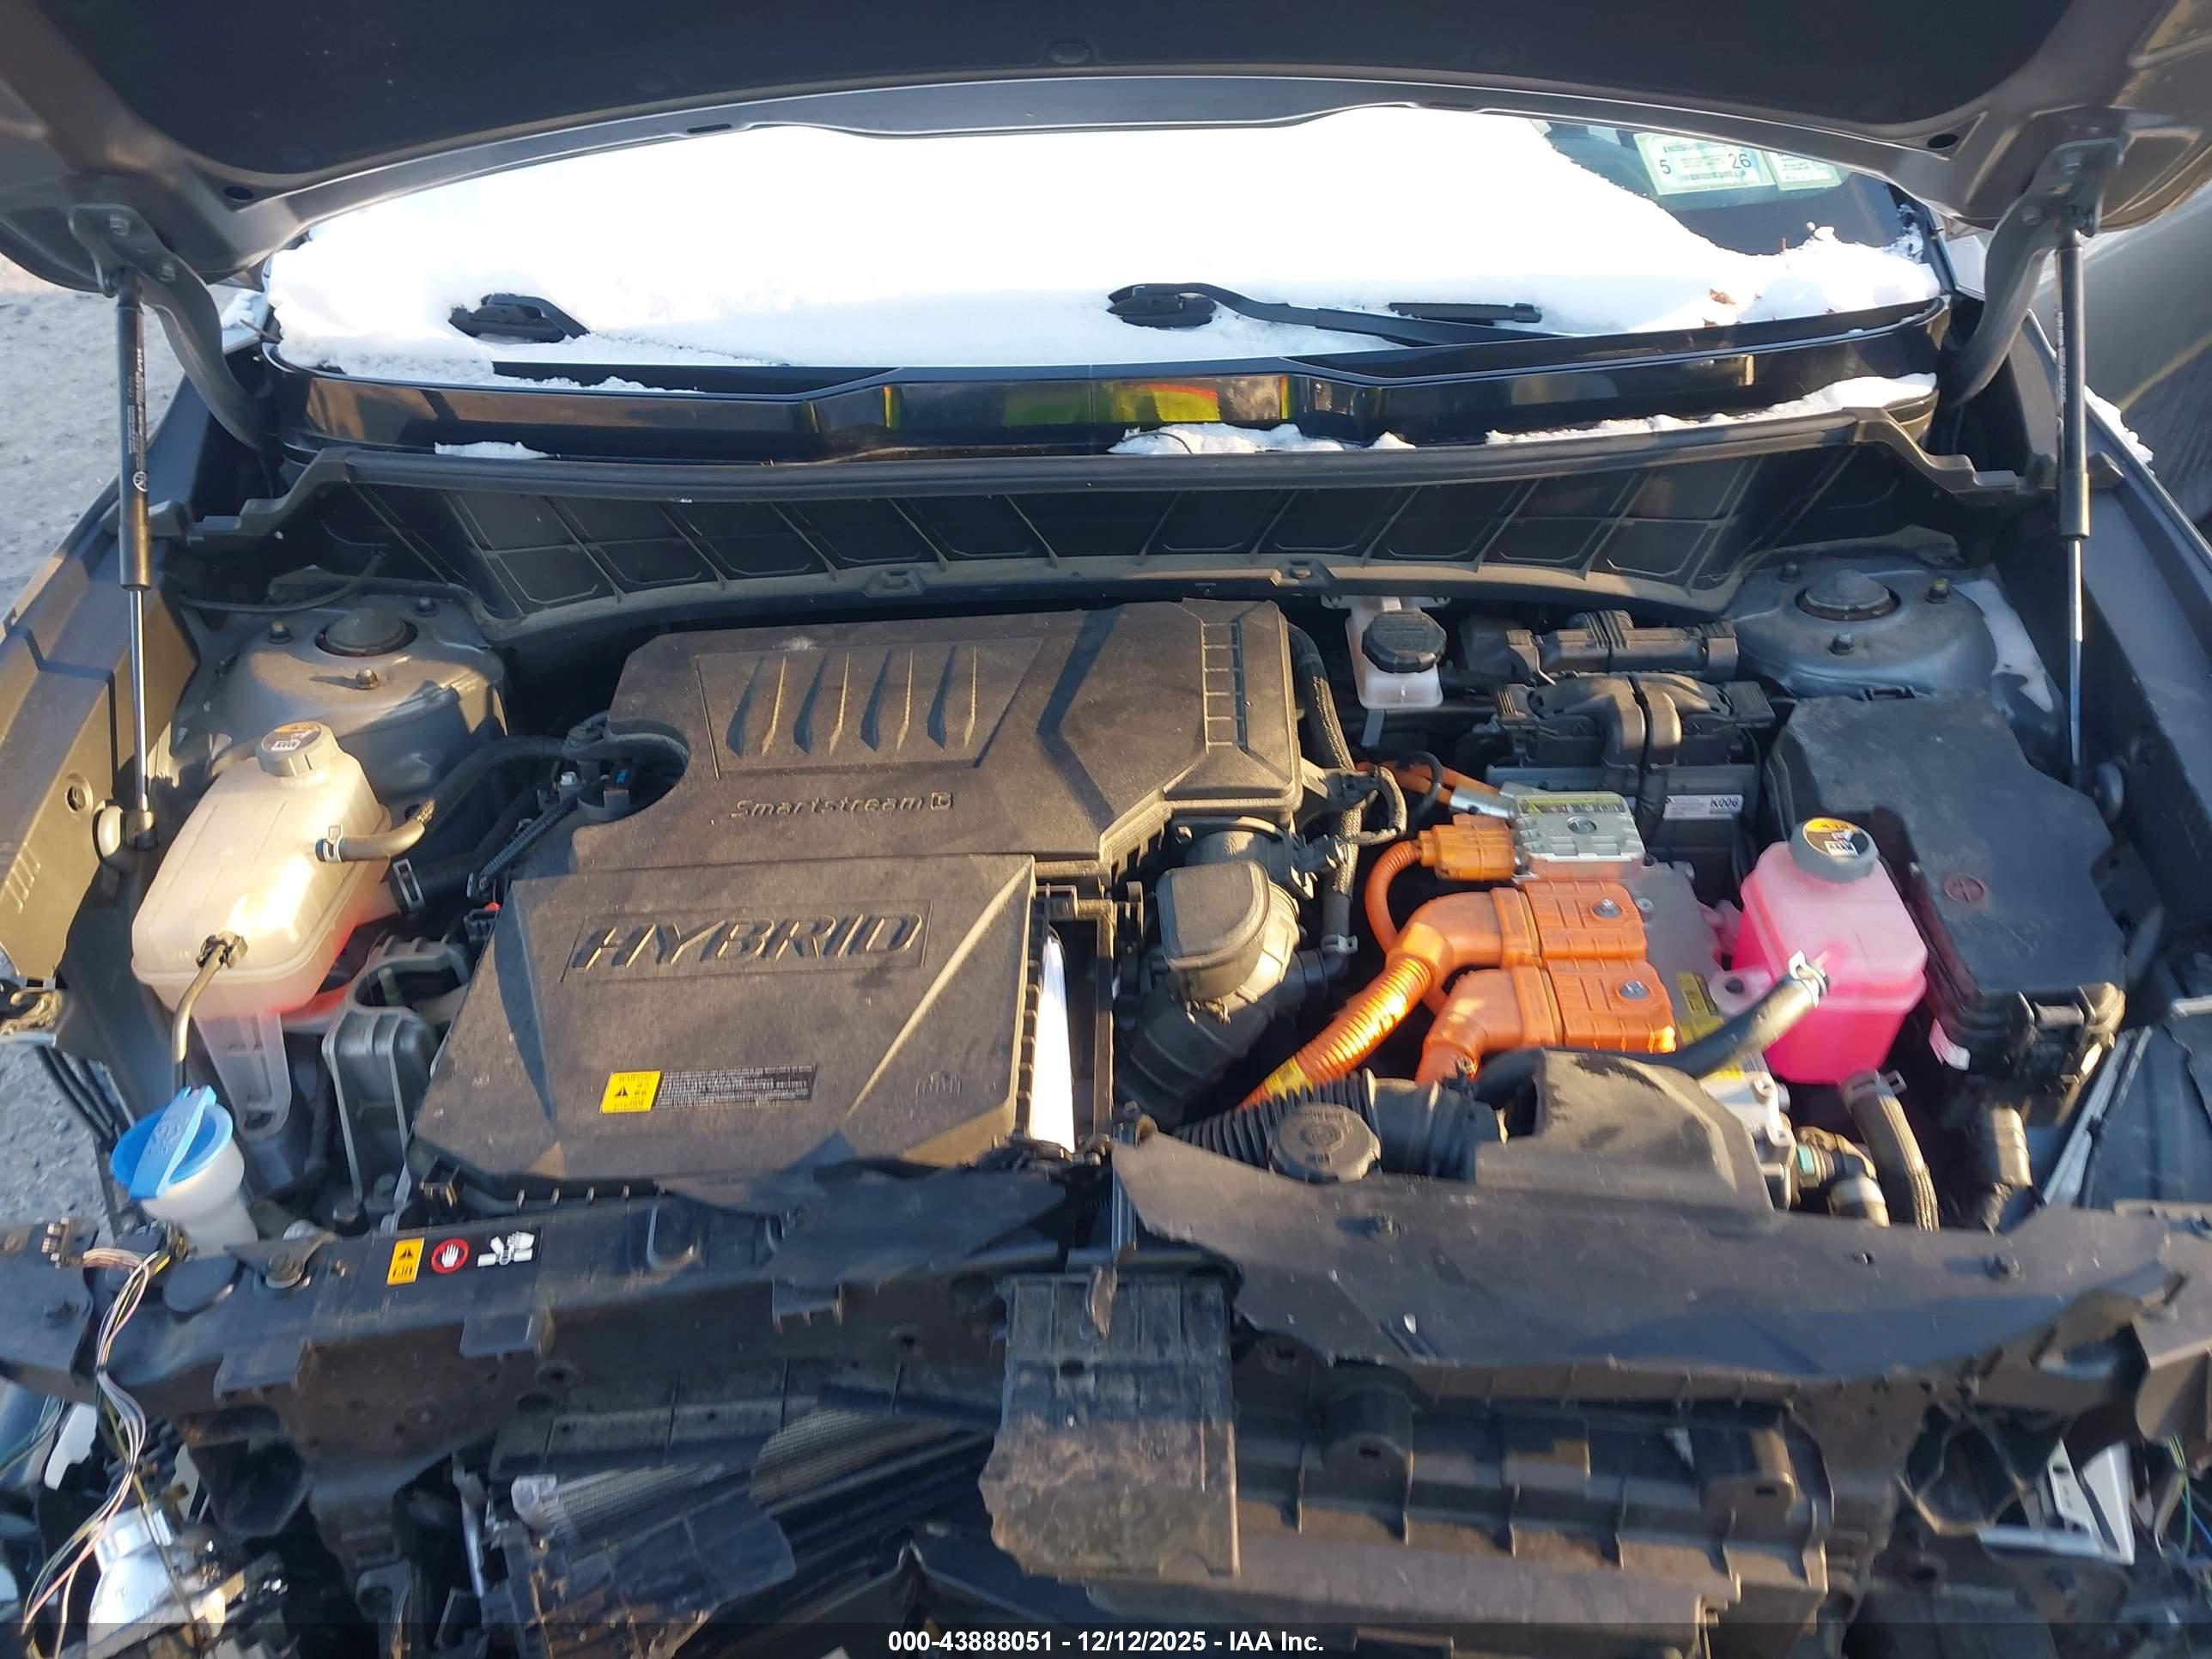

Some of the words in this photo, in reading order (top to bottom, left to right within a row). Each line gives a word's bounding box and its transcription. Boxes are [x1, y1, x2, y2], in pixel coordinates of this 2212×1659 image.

[1659, 159, 1671, 175] 5
[1728, 153, 1752, 169] 26
[730, 795, 925, 818] Smartstream
[572, 913, 923, 970] HYBRID
